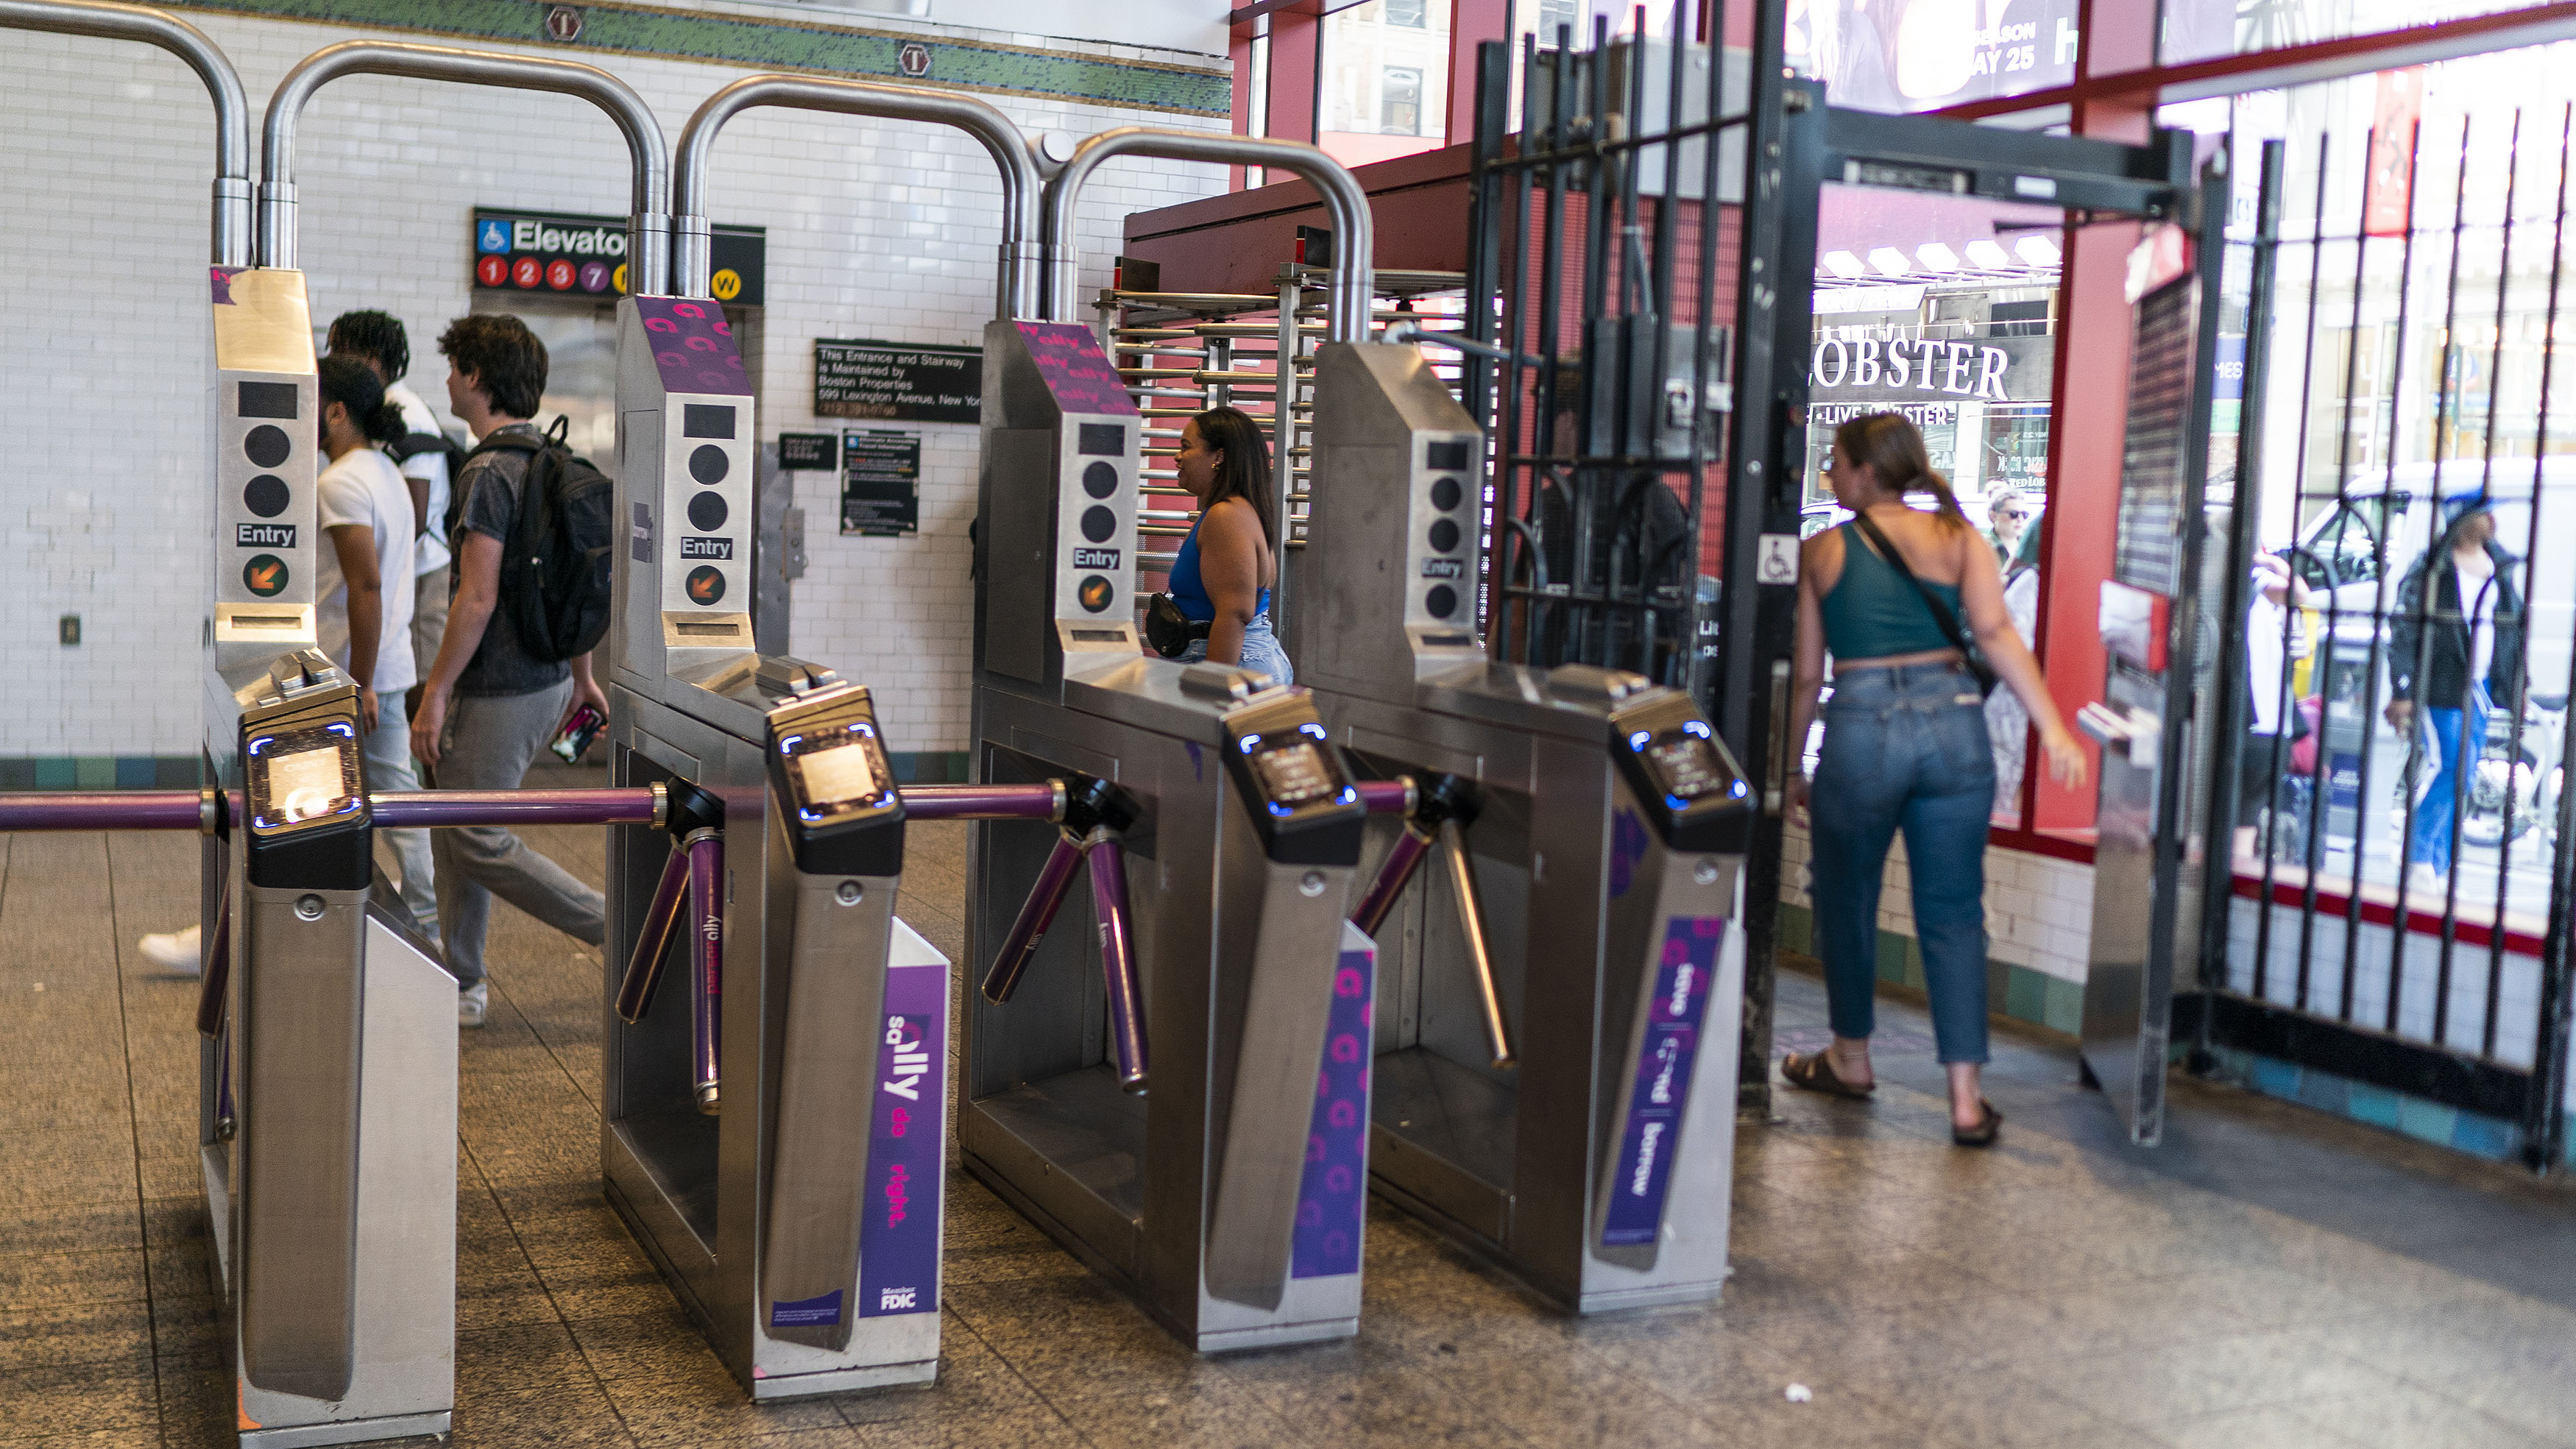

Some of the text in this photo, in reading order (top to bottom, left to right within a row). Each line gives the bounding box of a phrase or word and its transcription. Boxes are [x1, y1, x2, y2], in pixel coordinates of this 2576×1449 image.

[1971, 45, 2034, 76] AY 25
[514, 220, 628, 256] Elevato
[486, 261, 498, 282] 1
[520, 263, 534, 283] 2
[554, 264, 568, 285] 3
[589, 267, 602, 287] 7
[717, 277, 735, 293] W
[819, 349, 965, 369] This Entrance and Stairway
[819, 361, 905, 379] is Maintained by
[1812, 338, 2009, 402] OBSTER
[819, 375, 913, 391] Boston Properties
[842, 389, 892, 403] Lexington
[896, 392, 935, 405] Avenue,
[939, 394, 962, 405] New
[965, 396, 982, 406] Yor
[1826, 406, 1861, 425] LIVE
[238, 525, 294, 547] Entry
[682, 538, 731, 559] Entry
[1075, 550, 1118, 569] Entry
[1422, 558, 1460, 578] Entry
[891, 1108, 910, 1137] do
[1632, 1122, 1665, 1197] borrow
[885, 1164, 910, 1229] right.
[882, 1286, 916, 1294] Member
[880, 1293, 916, 1310] FDIC
